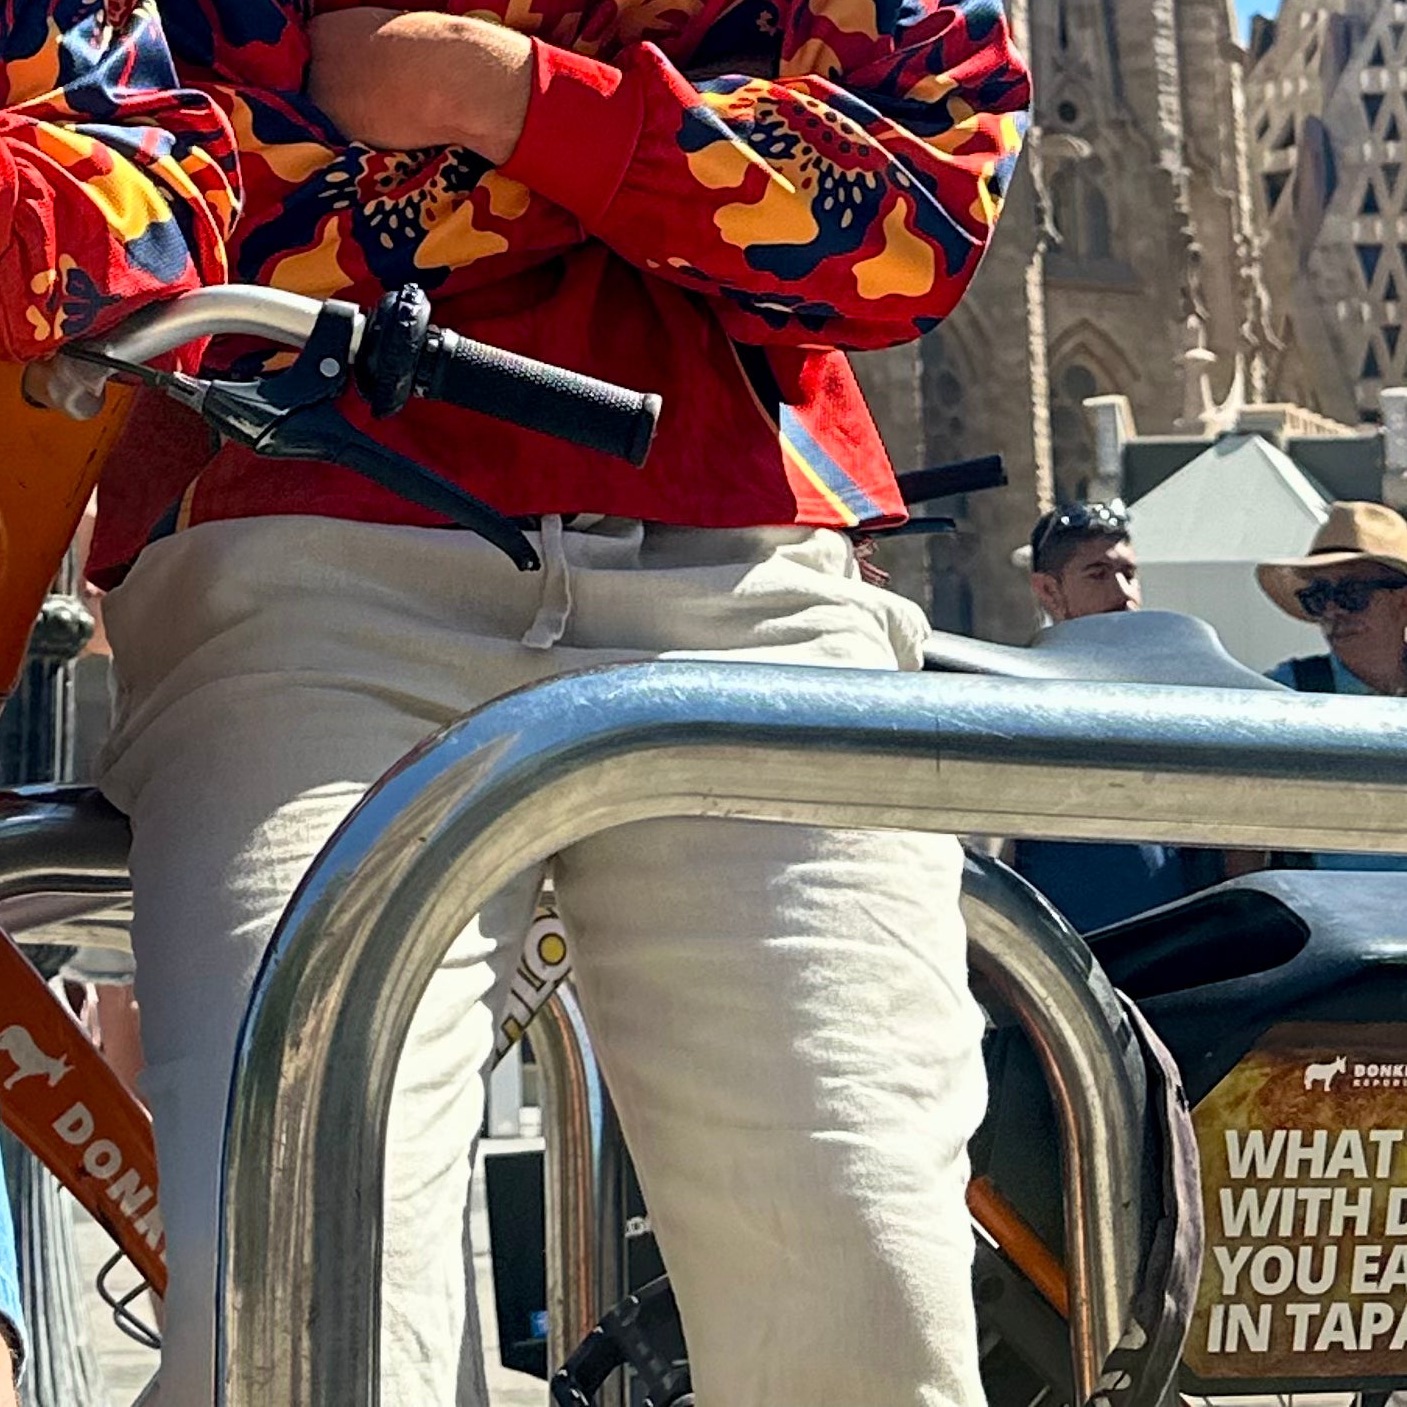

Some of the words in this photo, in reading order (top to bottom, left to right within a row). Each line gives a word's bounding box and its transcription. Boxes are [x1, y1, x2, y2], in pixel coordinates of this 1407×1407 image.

[1354, 1063, 1407, 1078] DONK
[1224, 1129, 1404, 1179] WHAT
[52, 1101, 167, 1266] DONK
[1219, 1187, 1373, 1237] WITH
[1212, 1245, 1338, 1295] YOU
[1206, 1303, 1273, 1353] IN
